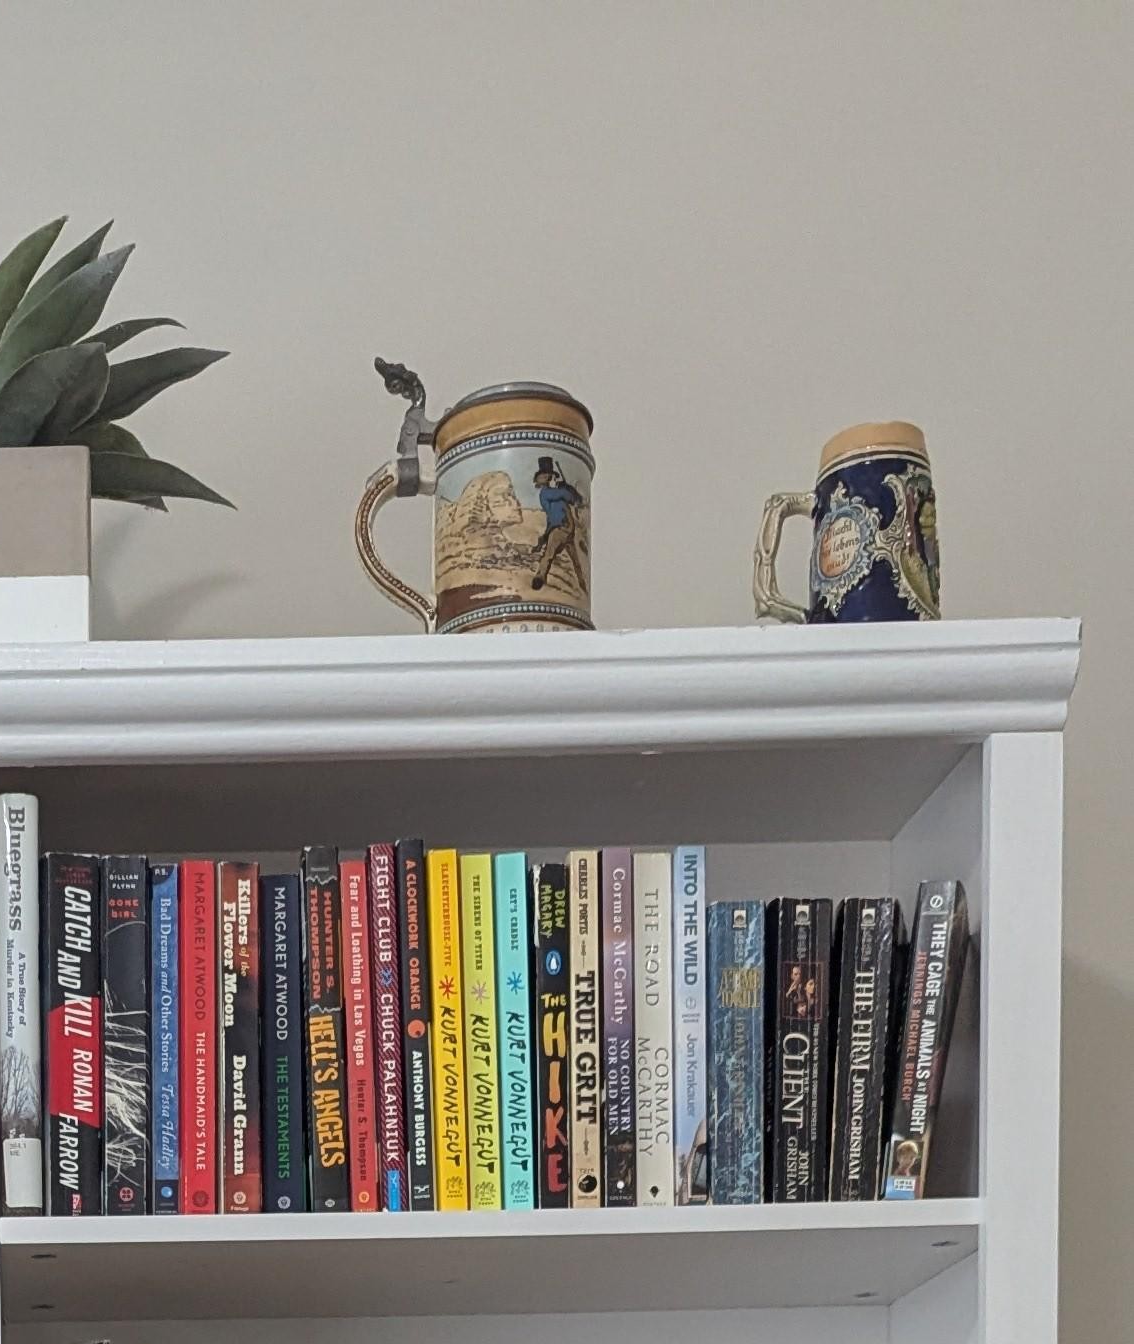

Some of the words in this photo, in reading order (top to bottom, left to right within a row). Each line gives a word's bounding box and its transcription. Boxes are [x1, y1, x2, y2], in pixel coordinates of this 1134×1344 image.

[4, 806, 26, 932] Bluegrass
[375, 855, 390, 910] FIGHT
[683, 854, 698, 896] INTO
[63, 886, 91, 953] CATCH
[193, 872, 206, 953] MARGARET
[378, 915, 391, 963] CLUB
[683, 900, 698, 936] THE
[56, 949, 78, 989] AND
[193, 956, 206, 1021] ATWOOD
[683, 939, 698, 986] WILD
[63, 992, 94, 1037] KILL
[379, 994, 395, 1051] CHUCK
[441, 1006, 457, 1060] KURT
[574, 970, 596, 1046] TRUE
[195, 1032, 206, 1055] THE
[276, 1056, 288, 1082] THE
[307, 1014, 339, 1083] HELL'S
[686, 1034, 694, 1057] Jon
[71, 1048, 94, 1112] RONAN
[195, 1058, 206, 1135] HANDMAID'S
[412, 1050, 424, 1109] ANTHONY
[575, 1052, 597, 1125] GRIT
[686, 1059, 698, 1118] Krakauer
[277, 1088, 291, 1179] TESTAMENTS
[313, 1088, 346, 1168] ANGELS
[382, 1060, 401, 1162] PALAHNIUK
[415, 1112, 427, 1167] BURGESS
[441, 1066, 464, 1168] VONNEGUT
[57, 1112, 78, 1190] FARROW
[195, 1137, 206, 1171] TALE
